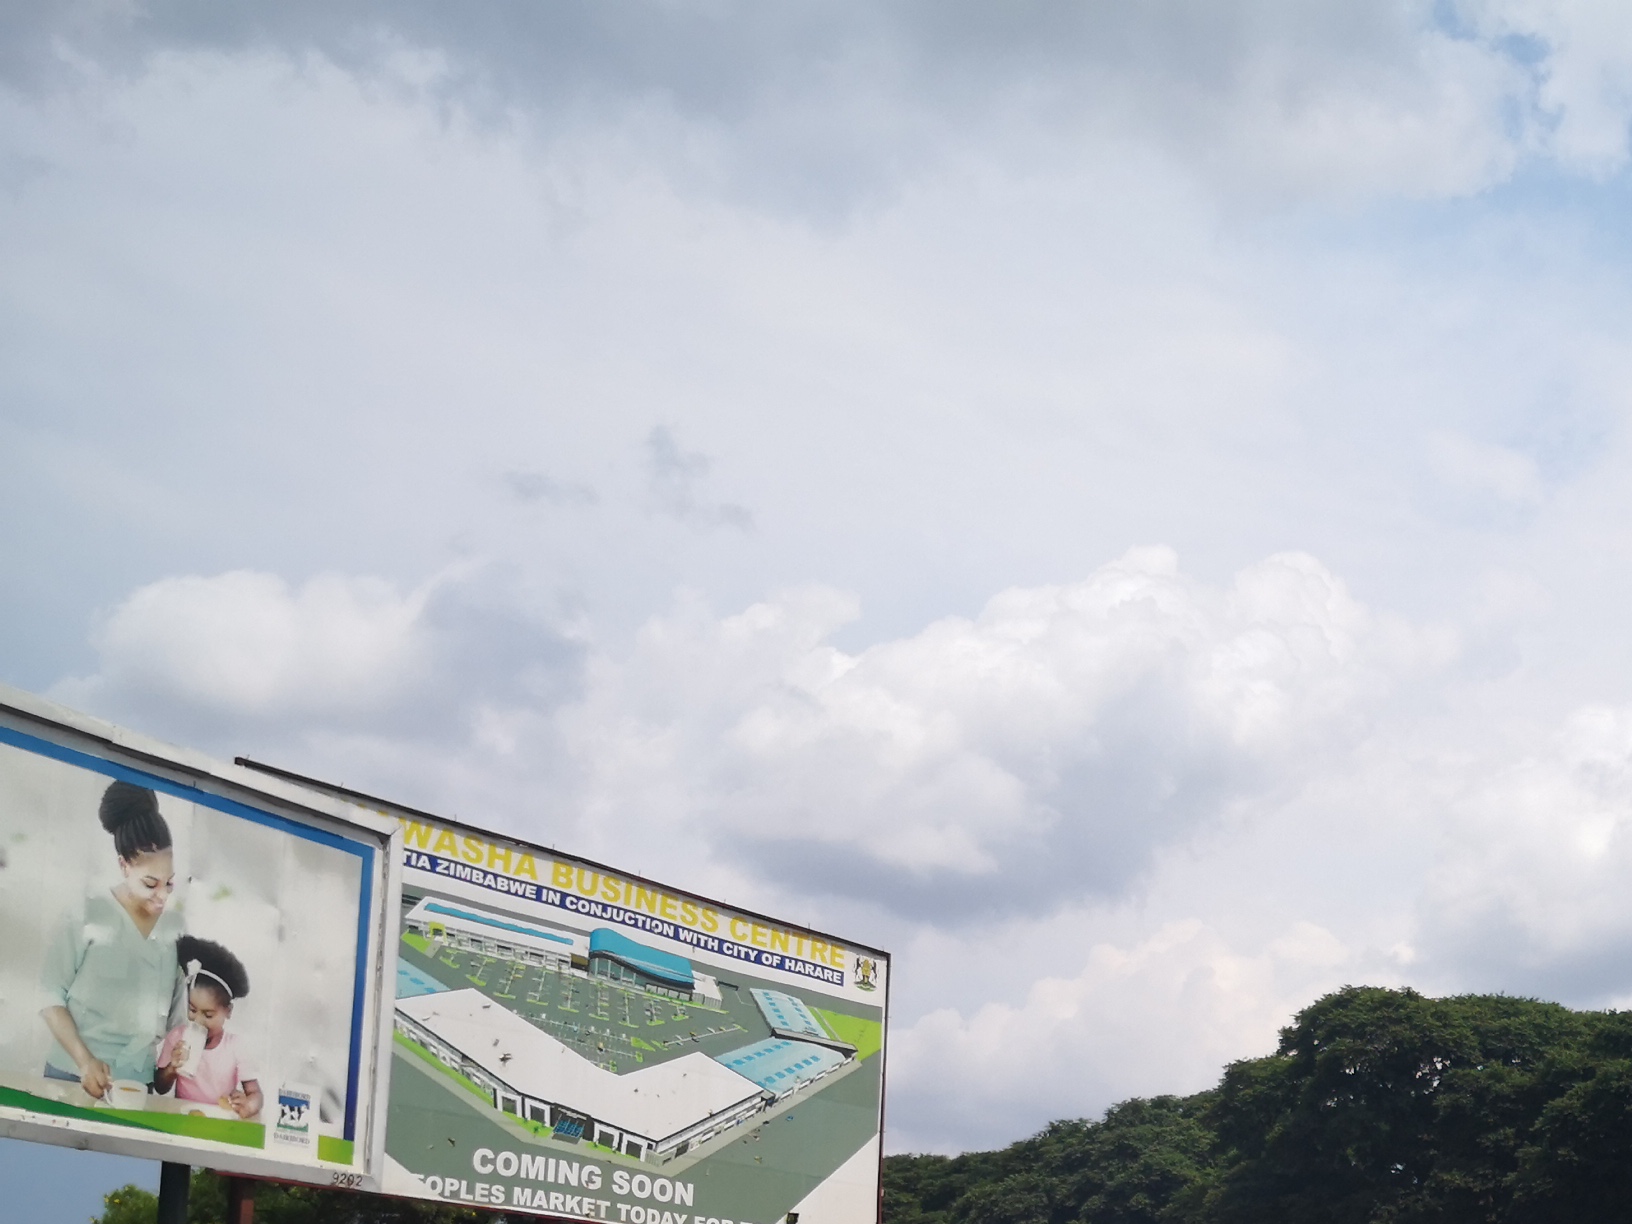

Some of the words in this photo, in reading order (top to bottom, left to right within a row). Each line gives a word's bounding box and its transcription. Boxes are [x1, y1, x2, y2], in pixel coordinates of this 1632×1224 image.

[398, 817, 538, 881] WASHA
[551, 860, 719, 933] BUSINESS
[729, 916, 846, 969] CENTRE
[435, 861, 537, 899] ZIMBABWE
[541, 889, 561, 906] IN
[565, 896, 674, 938] CONJUCTION
[678, 927, 719, 951] WITH
[722, 943, 759, 962] CITY
[761, 954, 782, 970] OF
[784, 959, 842, 984] HARARE
[332, 1172, 363, 1187] 9202
[473, 1148, 602, 1190] COMING
[612, 1170, 694, 1206] SOON
[513, 1187, 611, 1219] MARKET
